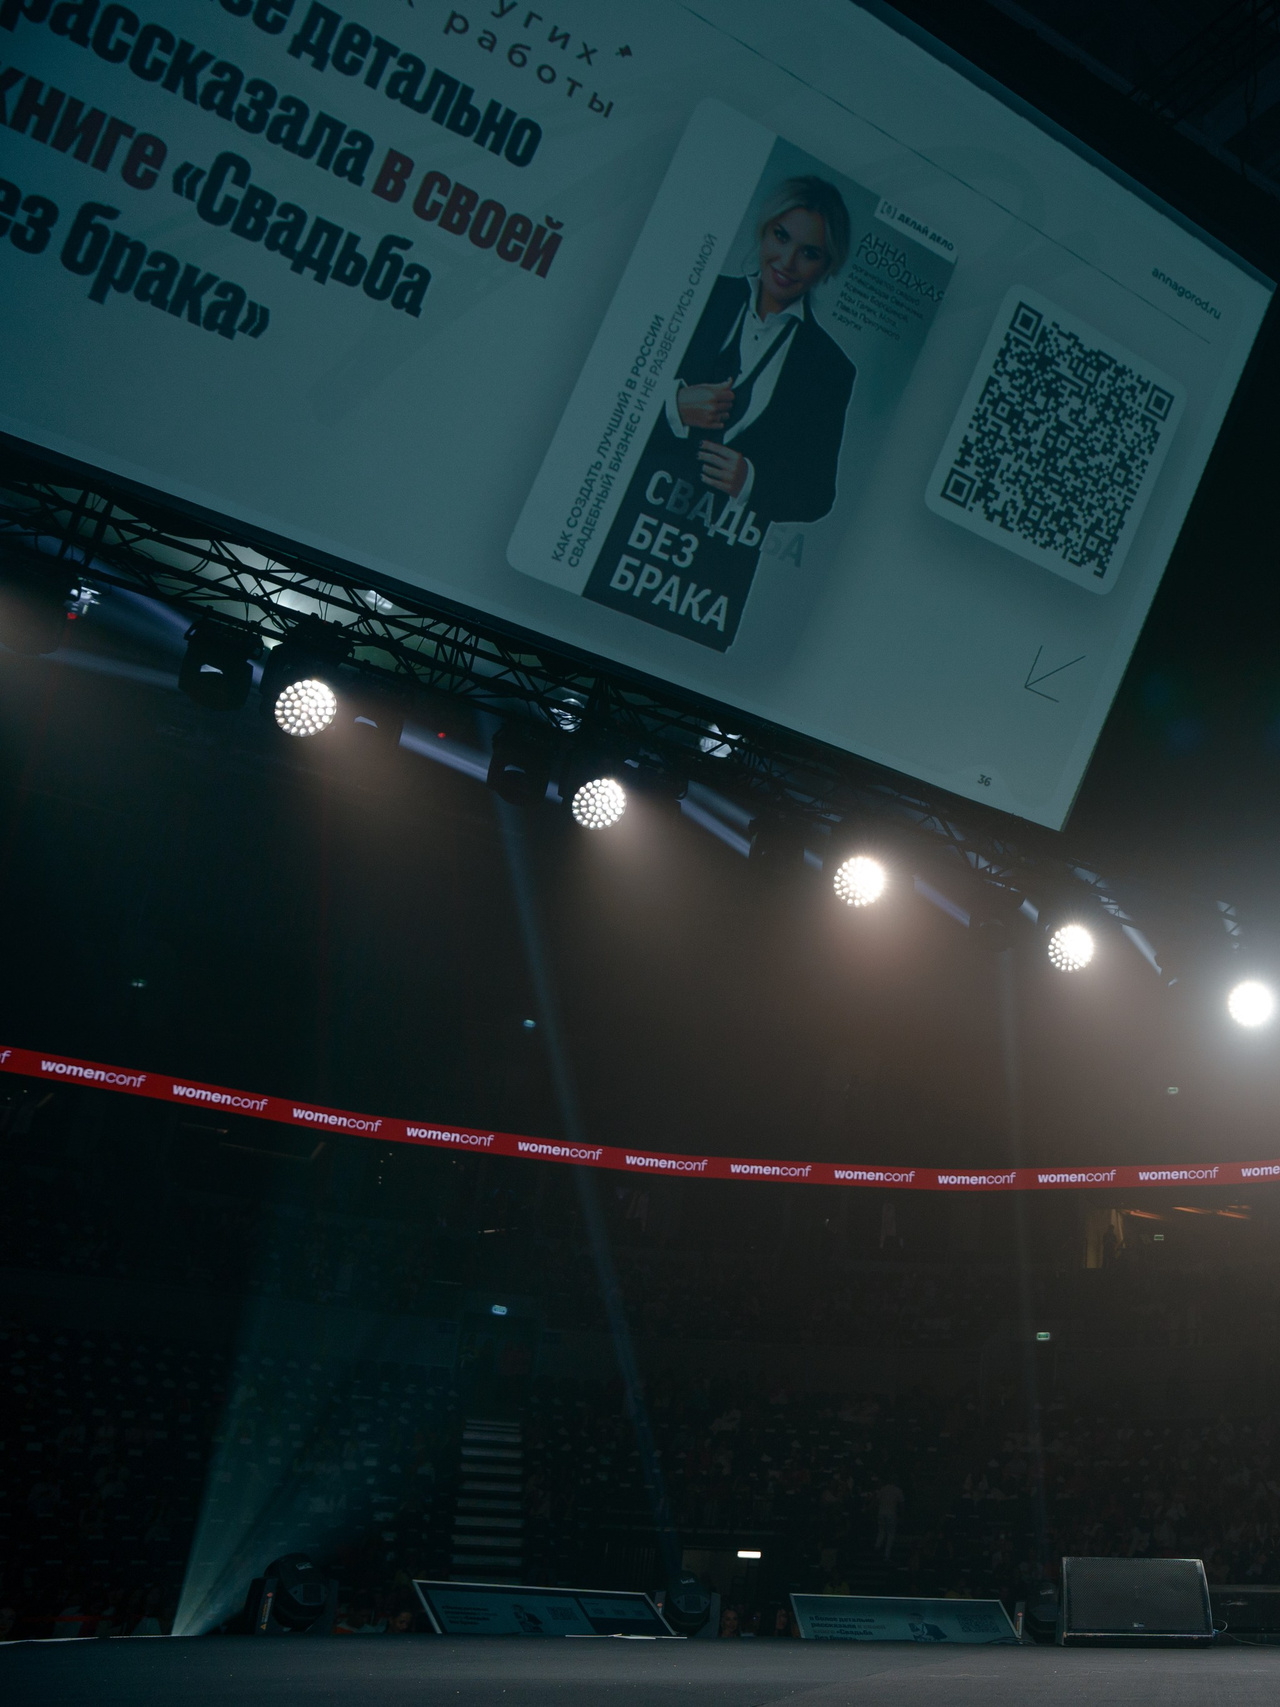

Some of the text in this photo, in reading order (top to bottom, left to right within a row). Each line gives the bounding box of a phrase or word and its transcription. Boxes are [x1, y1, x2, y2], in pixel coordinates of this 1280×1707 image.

[443, 10, 614, 118] работы
[287, 0, 542, 167] детально
[371, 148, 414, 203] в
[412, 171, 566, 279] своей
[172, 151, 431, 318] «Свадьба
[897, 213, 954, 252] ДЕЛАЙ ДЕЛО
[860, 232, 906, 268] АННА
[60, 201, 271, 340] брака»
[1151, 267, 1222, 320] annagorod.ru
[568, 232, 717, 568] СВАДЕБНЫЙ БИЗНЕС И НЕ РАЗВЕСТИСЬ САМОЙ
[552, 314, 664, 562] КАК СОЗДАТЬ ЛУЧШИЙ В РОССИИ
[627, 512, 699, 569] БЕЗ
[609, 553, 729, 633] БРАКА
[977, 774, 993, 788] 36
[41, 1059, 146, 1089] womenconf
[172, 1081, 269, 1112] womenconf
[292, 1105, 382, 1133] womenconf
[406, 1124, 495, 1148] womenconf
[517, 1140, 603, 1161] womenconf
[625, 1152, 708, 1172] womenconf
[730, 1161, 812, 1178] womenconf
[834, 1167, 916, 1183] womenconf
[937, 1171, 1016, 1185] womenconf
[1038, 1169, 1117, 1184] womenconf
[1138, 1166, 1219, 1181] womenconf
